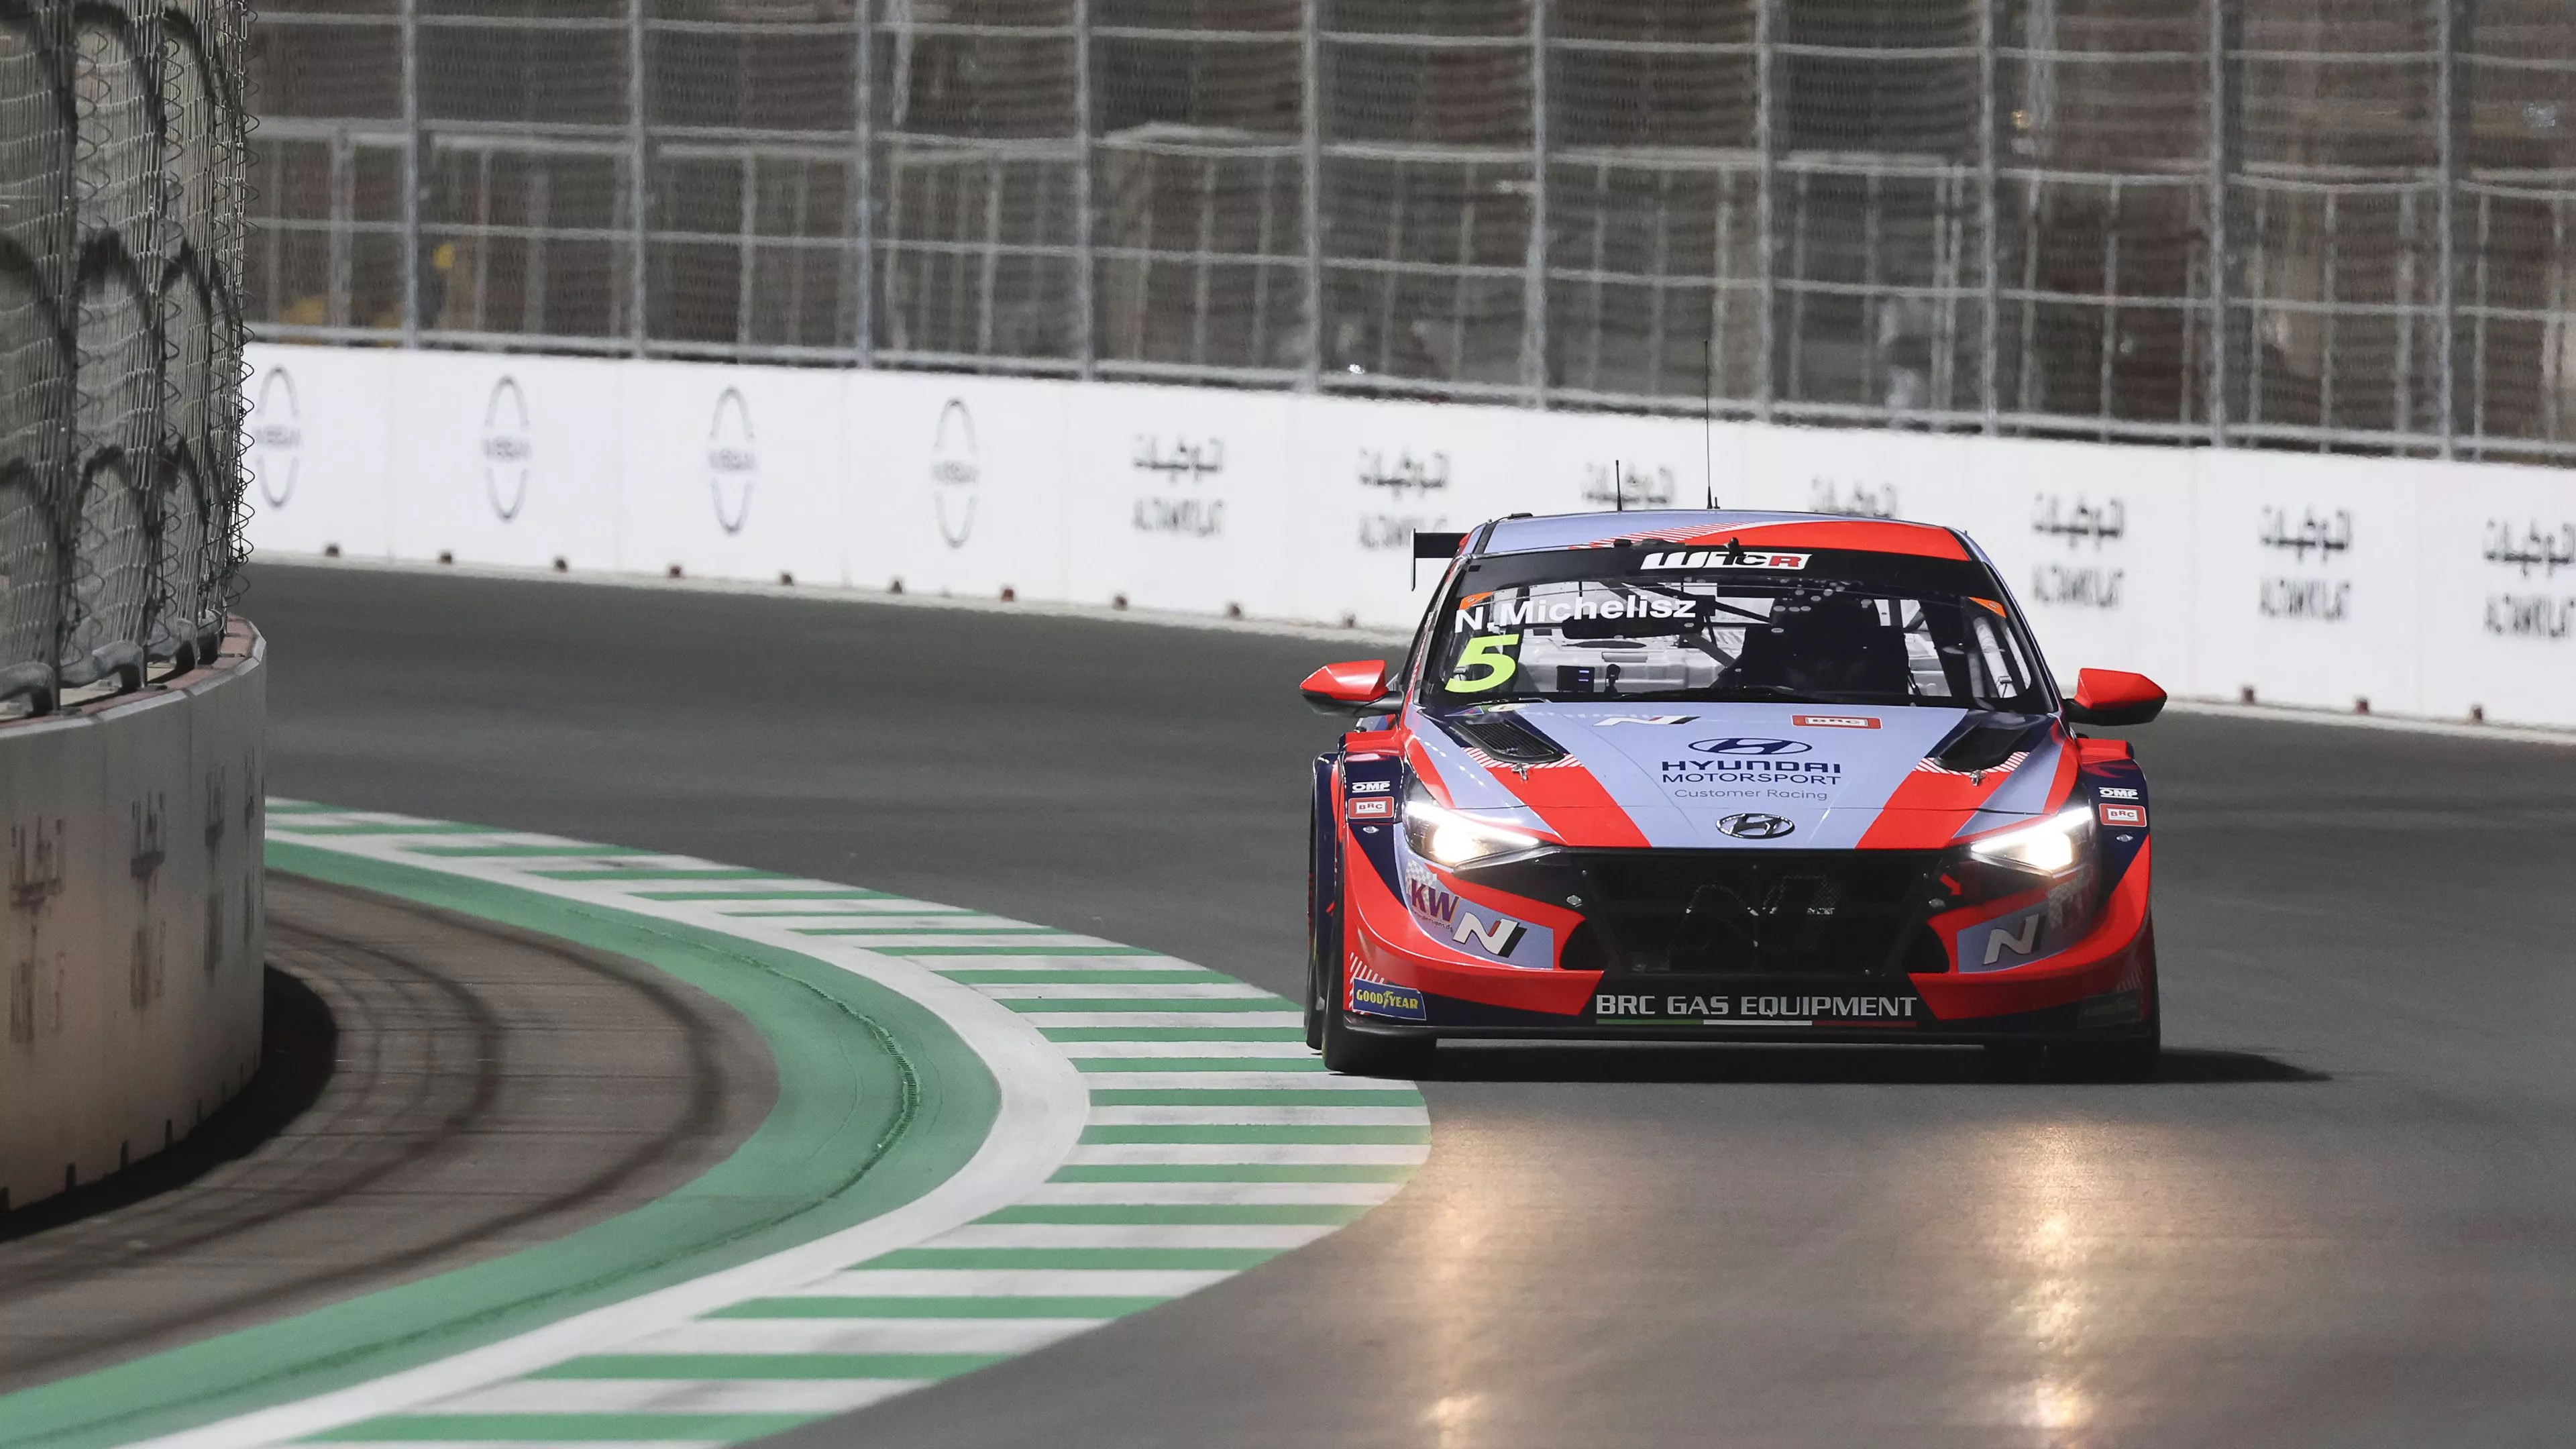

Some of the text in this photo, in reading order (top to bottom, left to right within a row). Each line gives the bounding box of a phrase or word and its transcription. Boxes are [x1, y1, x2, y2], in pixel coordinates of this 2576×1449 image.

[1640, 551, 1812, 570] WTCR
[1444, 634, 1519, 694] 5
[1662, 760, 1841, 773] HYUNDAI
[1662, 773, 1841, 785] MOTORSPORT
[1352, 782, 1391, 792] OMP
[2099, 788, 2139, 799] OMP
[1674, 789, 1828, 801] Customer Racing
[1411, 878, 1460, 923] KW
[1596, 994, 1917, 1017] BRC GAS EQUIPMENT
